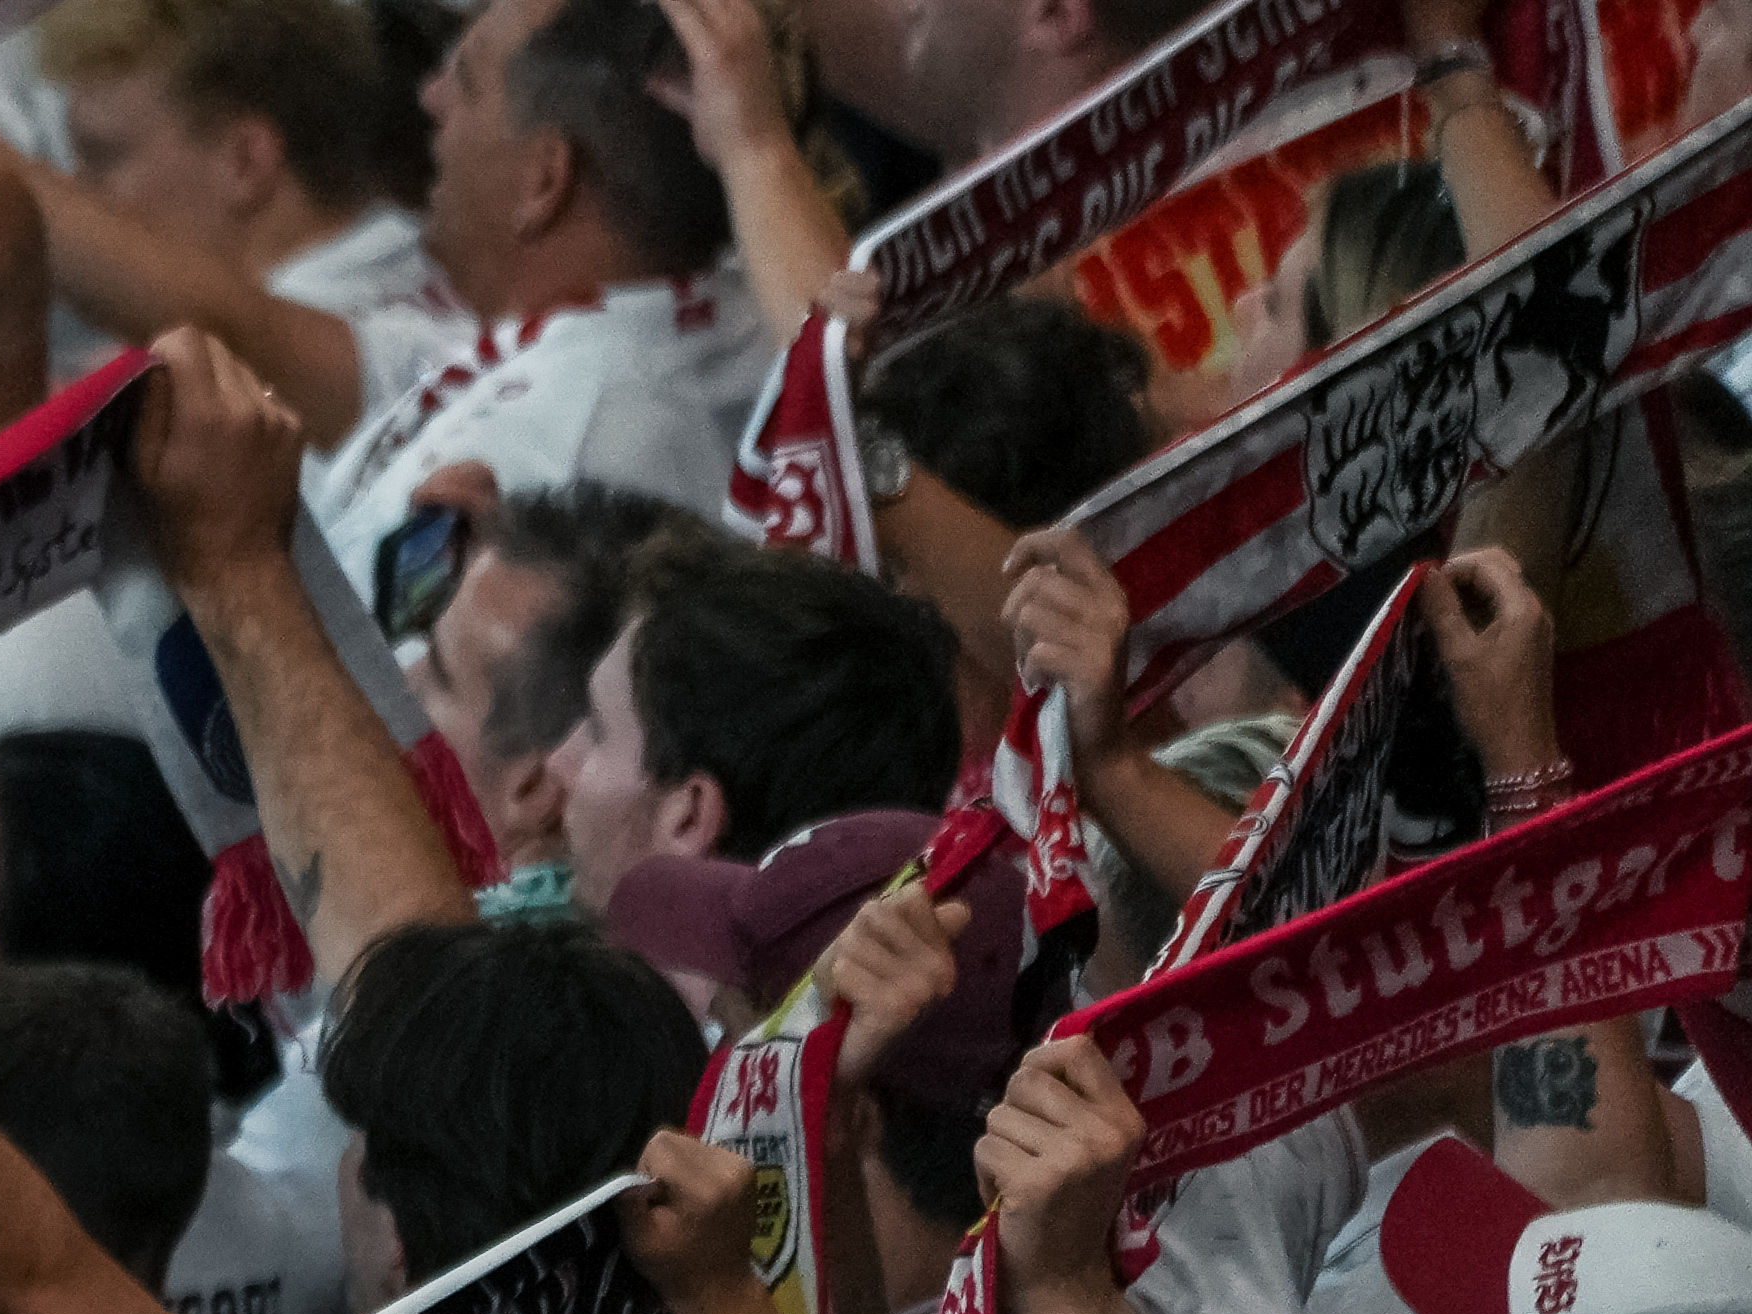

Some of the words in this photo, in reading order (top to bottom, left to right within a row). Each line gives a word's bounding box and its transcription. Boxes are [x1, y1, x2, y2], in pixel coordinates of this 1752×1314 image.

[1248, 1069, 1306, 1130] DER
[1315, 974, 1548, 1102] MERCEDES-BENZ
[1559, 938, 1674, 1003] ARENA
